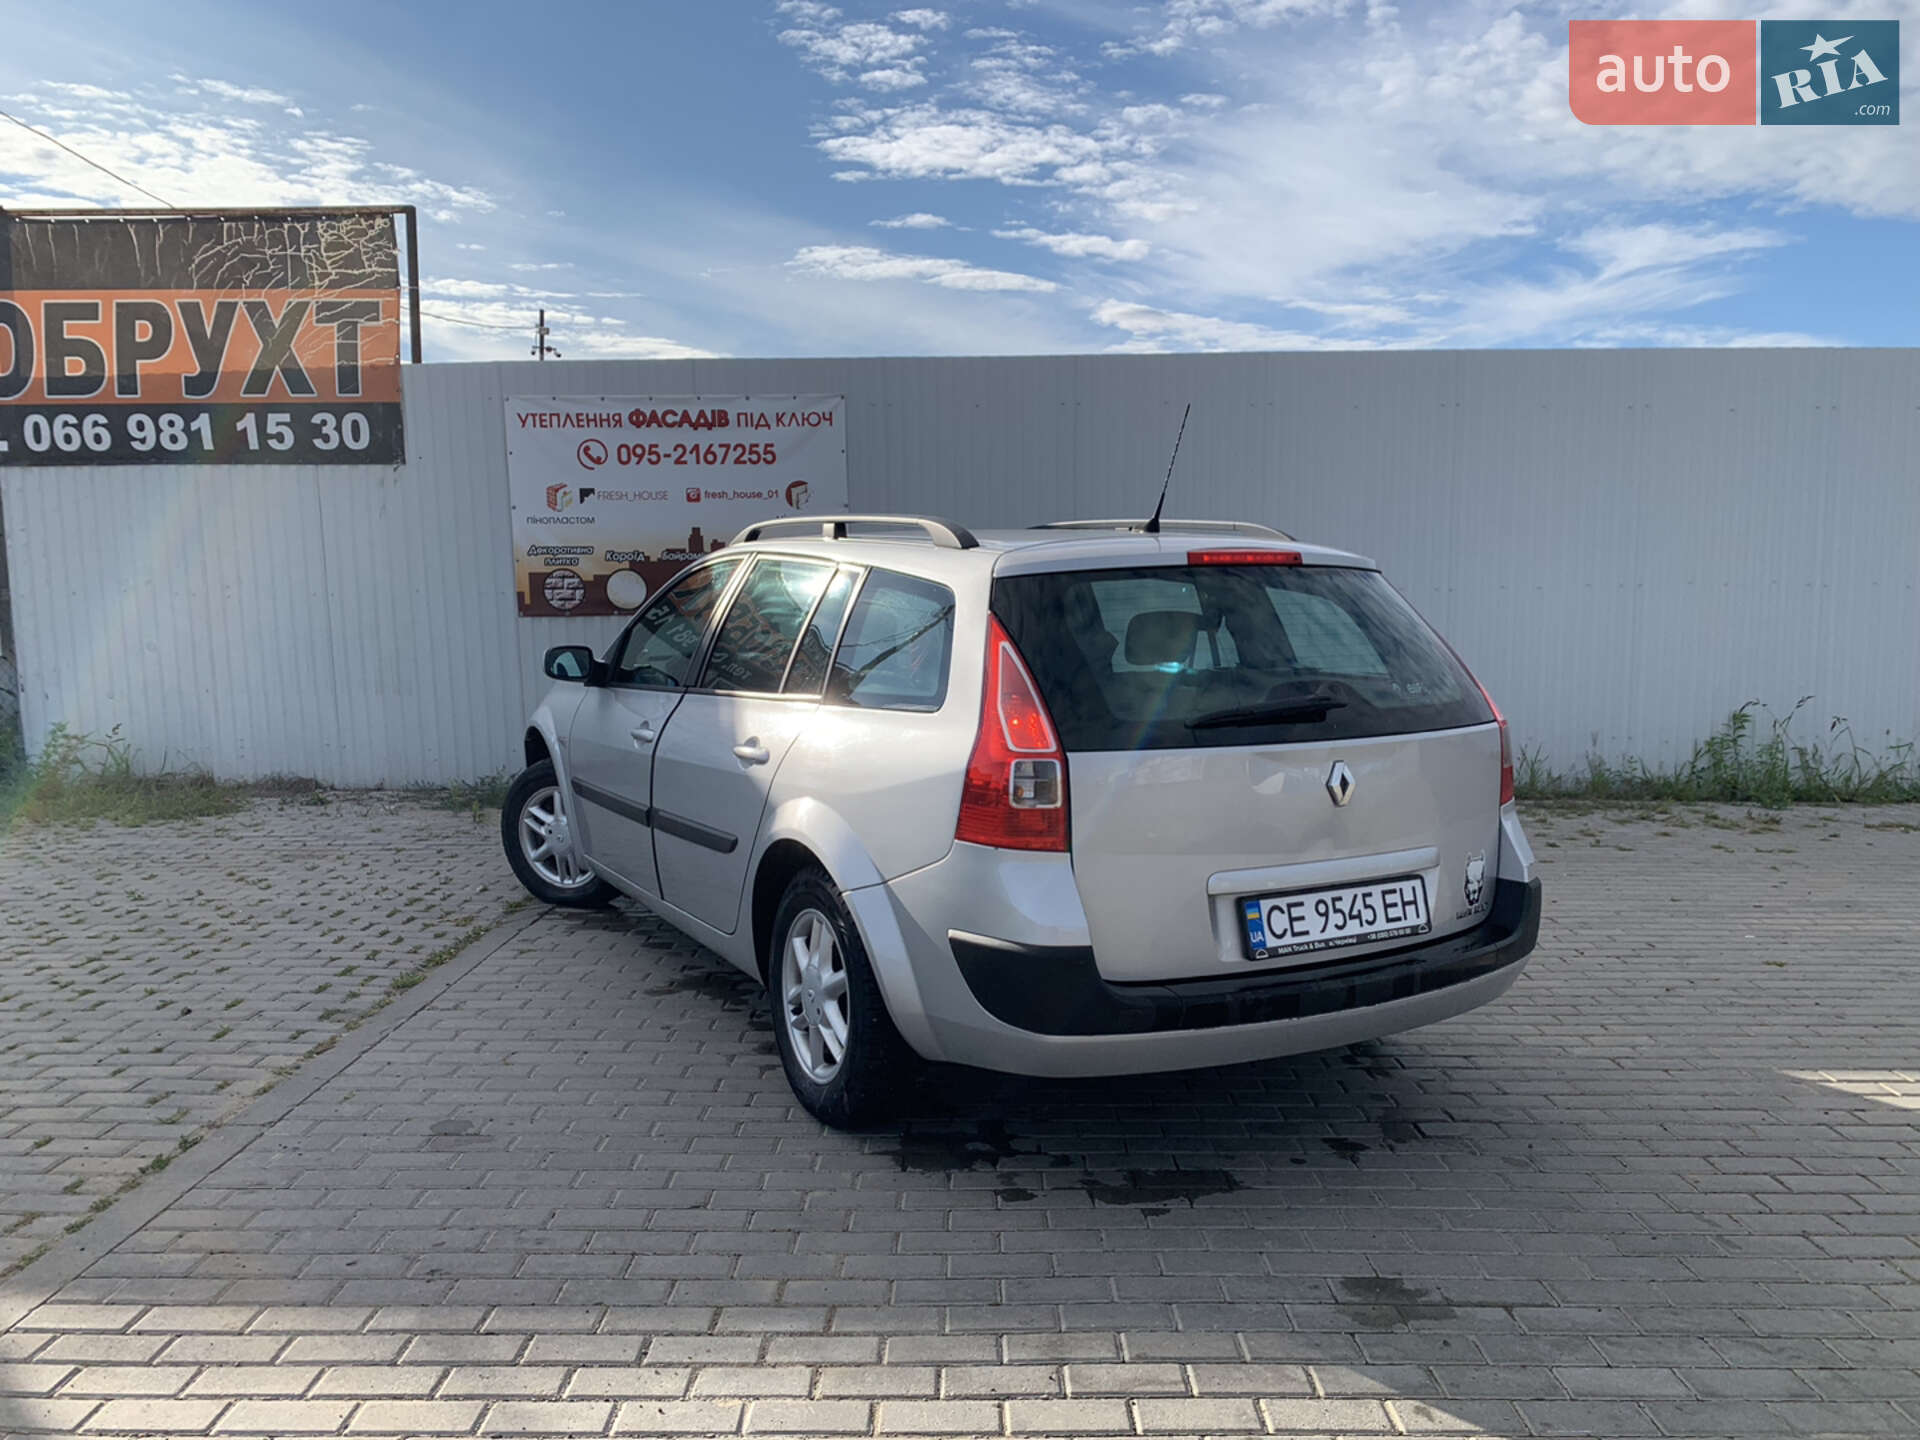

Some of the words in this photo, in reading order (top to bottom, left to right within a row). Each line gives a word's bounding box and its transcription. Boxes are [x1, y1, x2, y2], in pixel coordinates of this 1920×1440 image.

[516, 412, 623, 429] УТЕПЛЕННЯ
[627, 409, 730, 430] ФАСАДІВ
[737, 411, 771, 429] ПІД
[776, 411, 834, 428] КЛЮЧ
[23, 413, 113, 453] 066
[126, 412, 215, 452] 981
[235, 412, 295, 451] 15
[310, 411, 371, 452] 30
[616, 443, 777, 465] 095-2167255
[597, 490, 669, 502] FRESH_HOUSE
[704, 488, 779, 500] fresh_house_01
[605, 550, 645, 562] Короїд
[1266, 902, 1310, 940] CE
[1314, 891, 1378, 934] 9545
[1383, 885, 1422, 924] EH
[1250, 931, 1264, 943] UA
